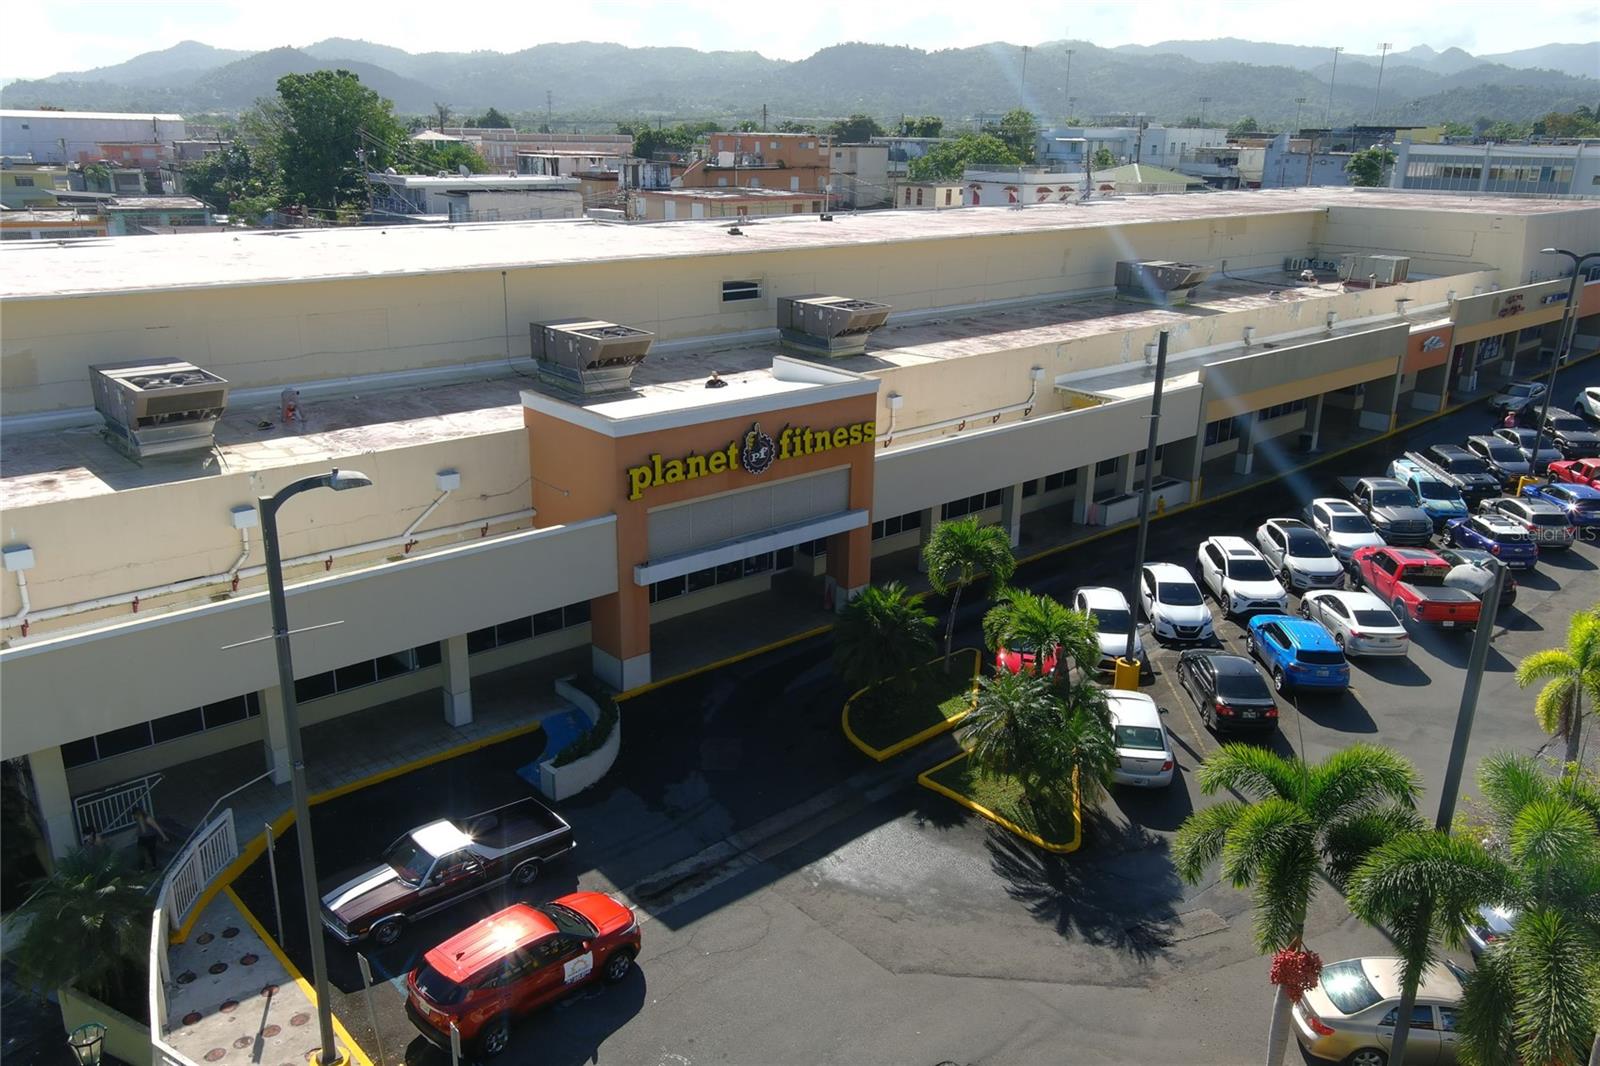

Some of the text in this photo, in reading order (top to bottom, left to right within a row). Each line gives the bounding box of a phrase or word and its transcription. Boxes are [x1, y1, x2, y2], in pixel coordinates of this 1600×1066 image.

[628, 421, 876, 500] planet fitness
[751, 447, 768, 462] pf
